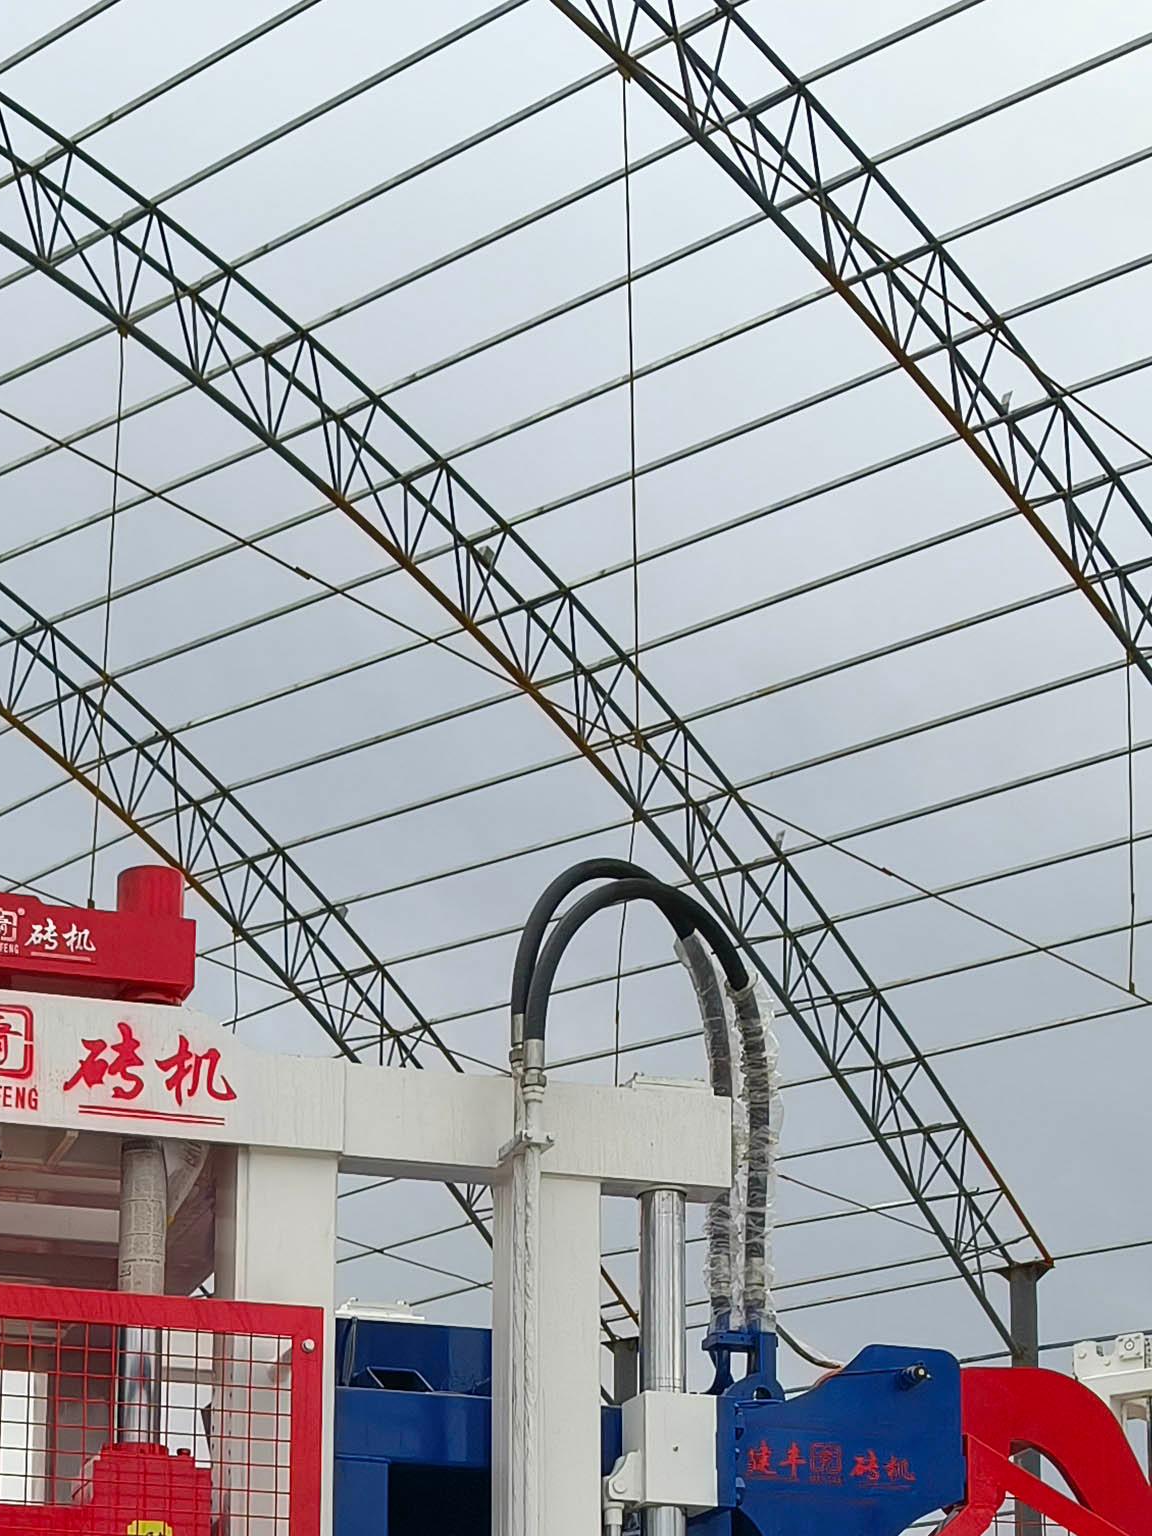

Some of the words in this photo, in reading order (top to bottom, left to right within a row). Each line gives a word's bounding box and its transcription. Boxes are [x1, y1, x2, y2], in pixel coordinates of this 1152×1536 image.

[0, 943, 20, 955] FENG
[24, 917, 96, 953] 砖机
[62, 1021, 237, 1107] 砖机
